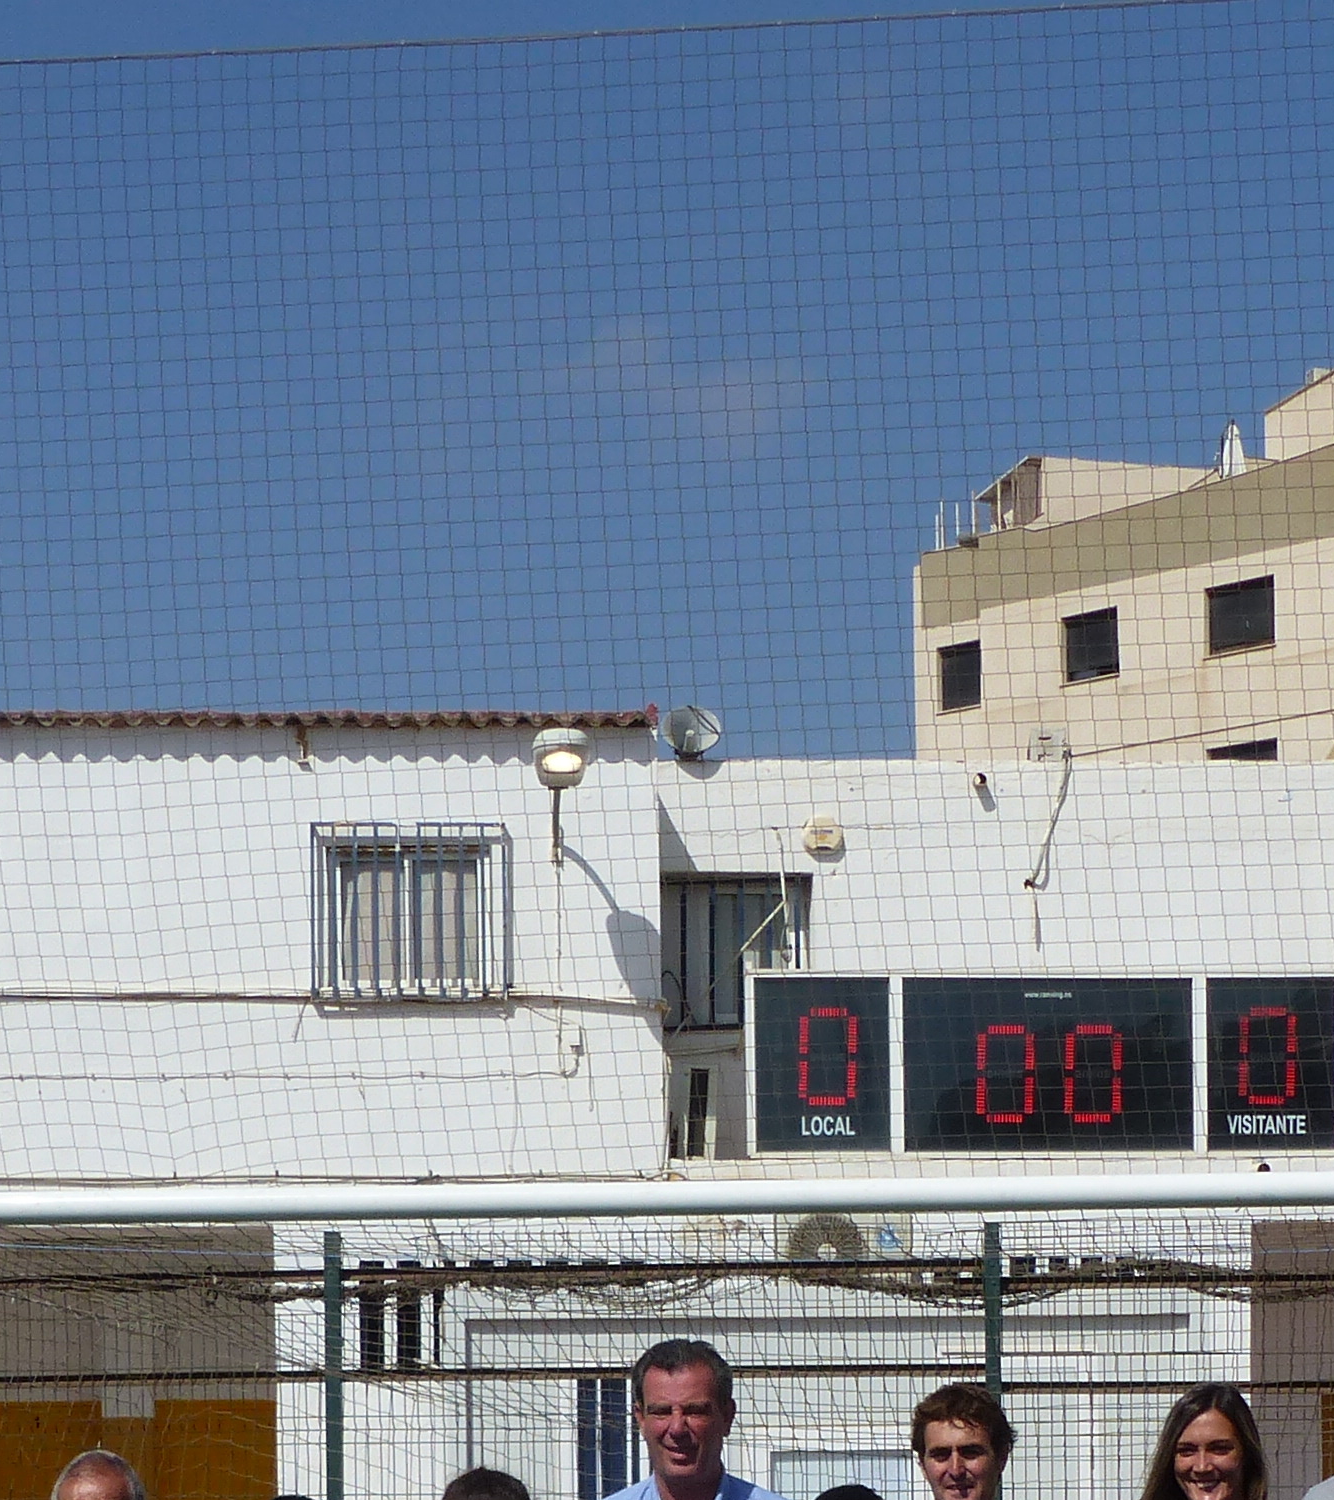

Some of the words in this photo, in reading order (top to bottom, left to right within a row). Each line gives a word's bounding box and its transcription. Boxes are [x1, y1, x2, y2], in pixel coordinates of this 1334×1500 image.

[798, 1007, 858, 1107] 0
[1239, 1007, 1297, 1106] 0
[800, 1115, 856, 1137] LOCAL
[1226, 1114, 1307, 1136] VISITANTE
